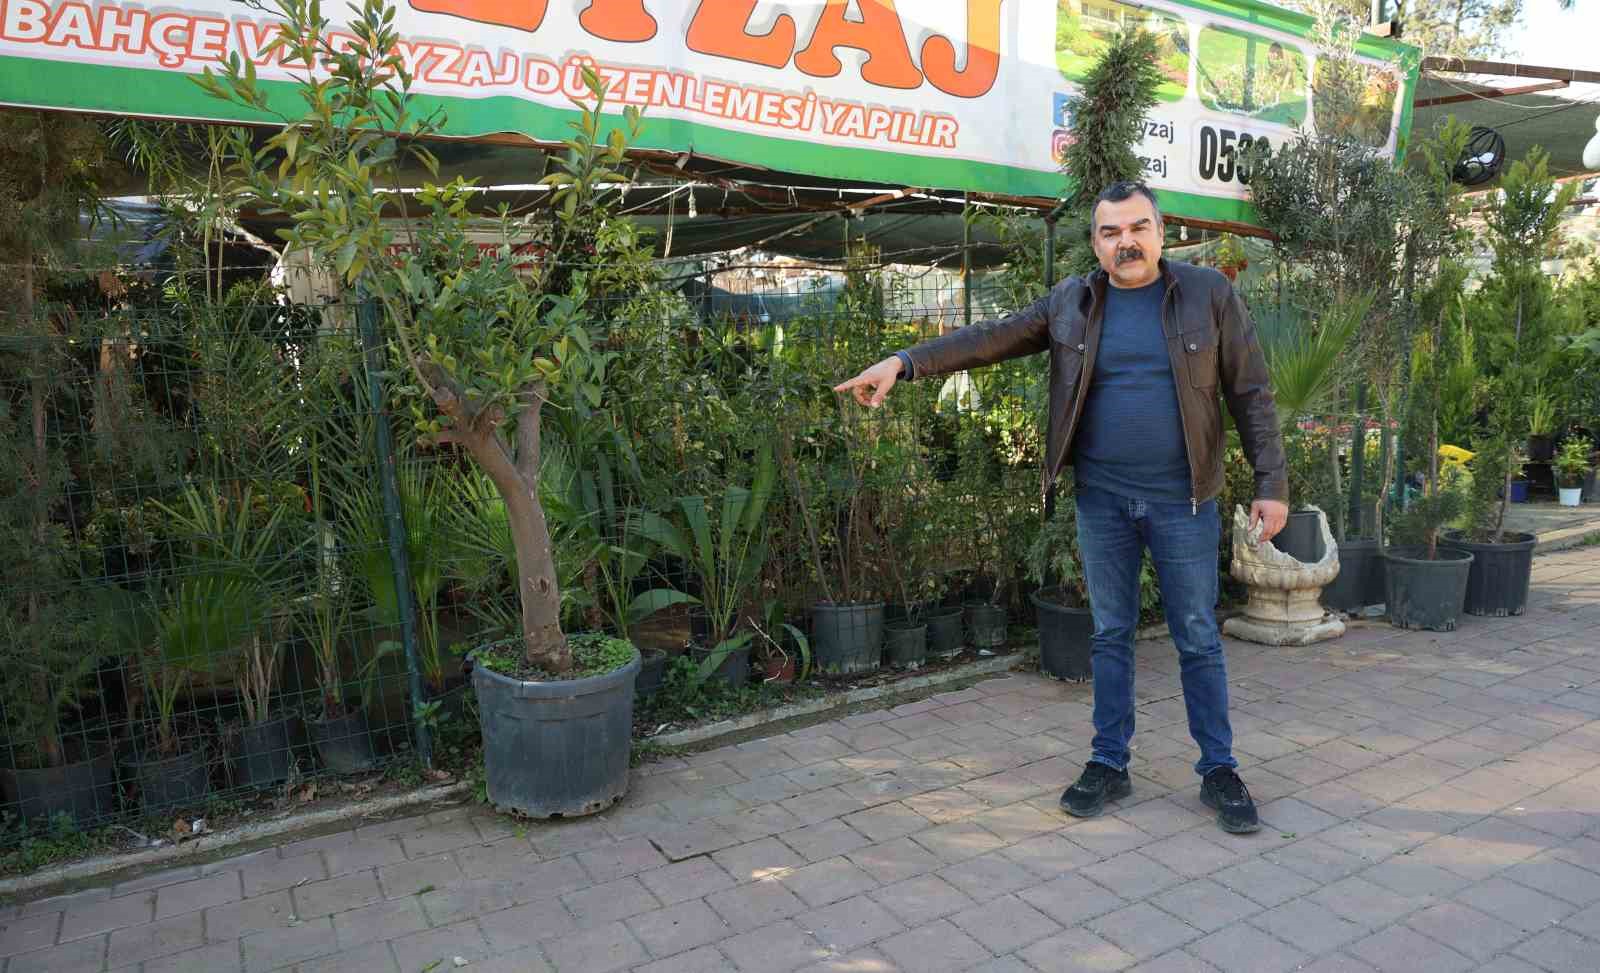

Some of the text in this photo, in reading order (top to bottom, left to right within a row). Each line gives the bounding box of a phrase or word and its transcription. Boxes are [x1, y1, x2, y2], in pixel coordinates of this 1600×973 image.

[0, 0, 231, 68] BAHÇE
[525, 56, 820, 132] DÜZENLEMESİ
[819, 101, 959, 148] YAPILIR
[1142, 155, 1167, 178] zaj
